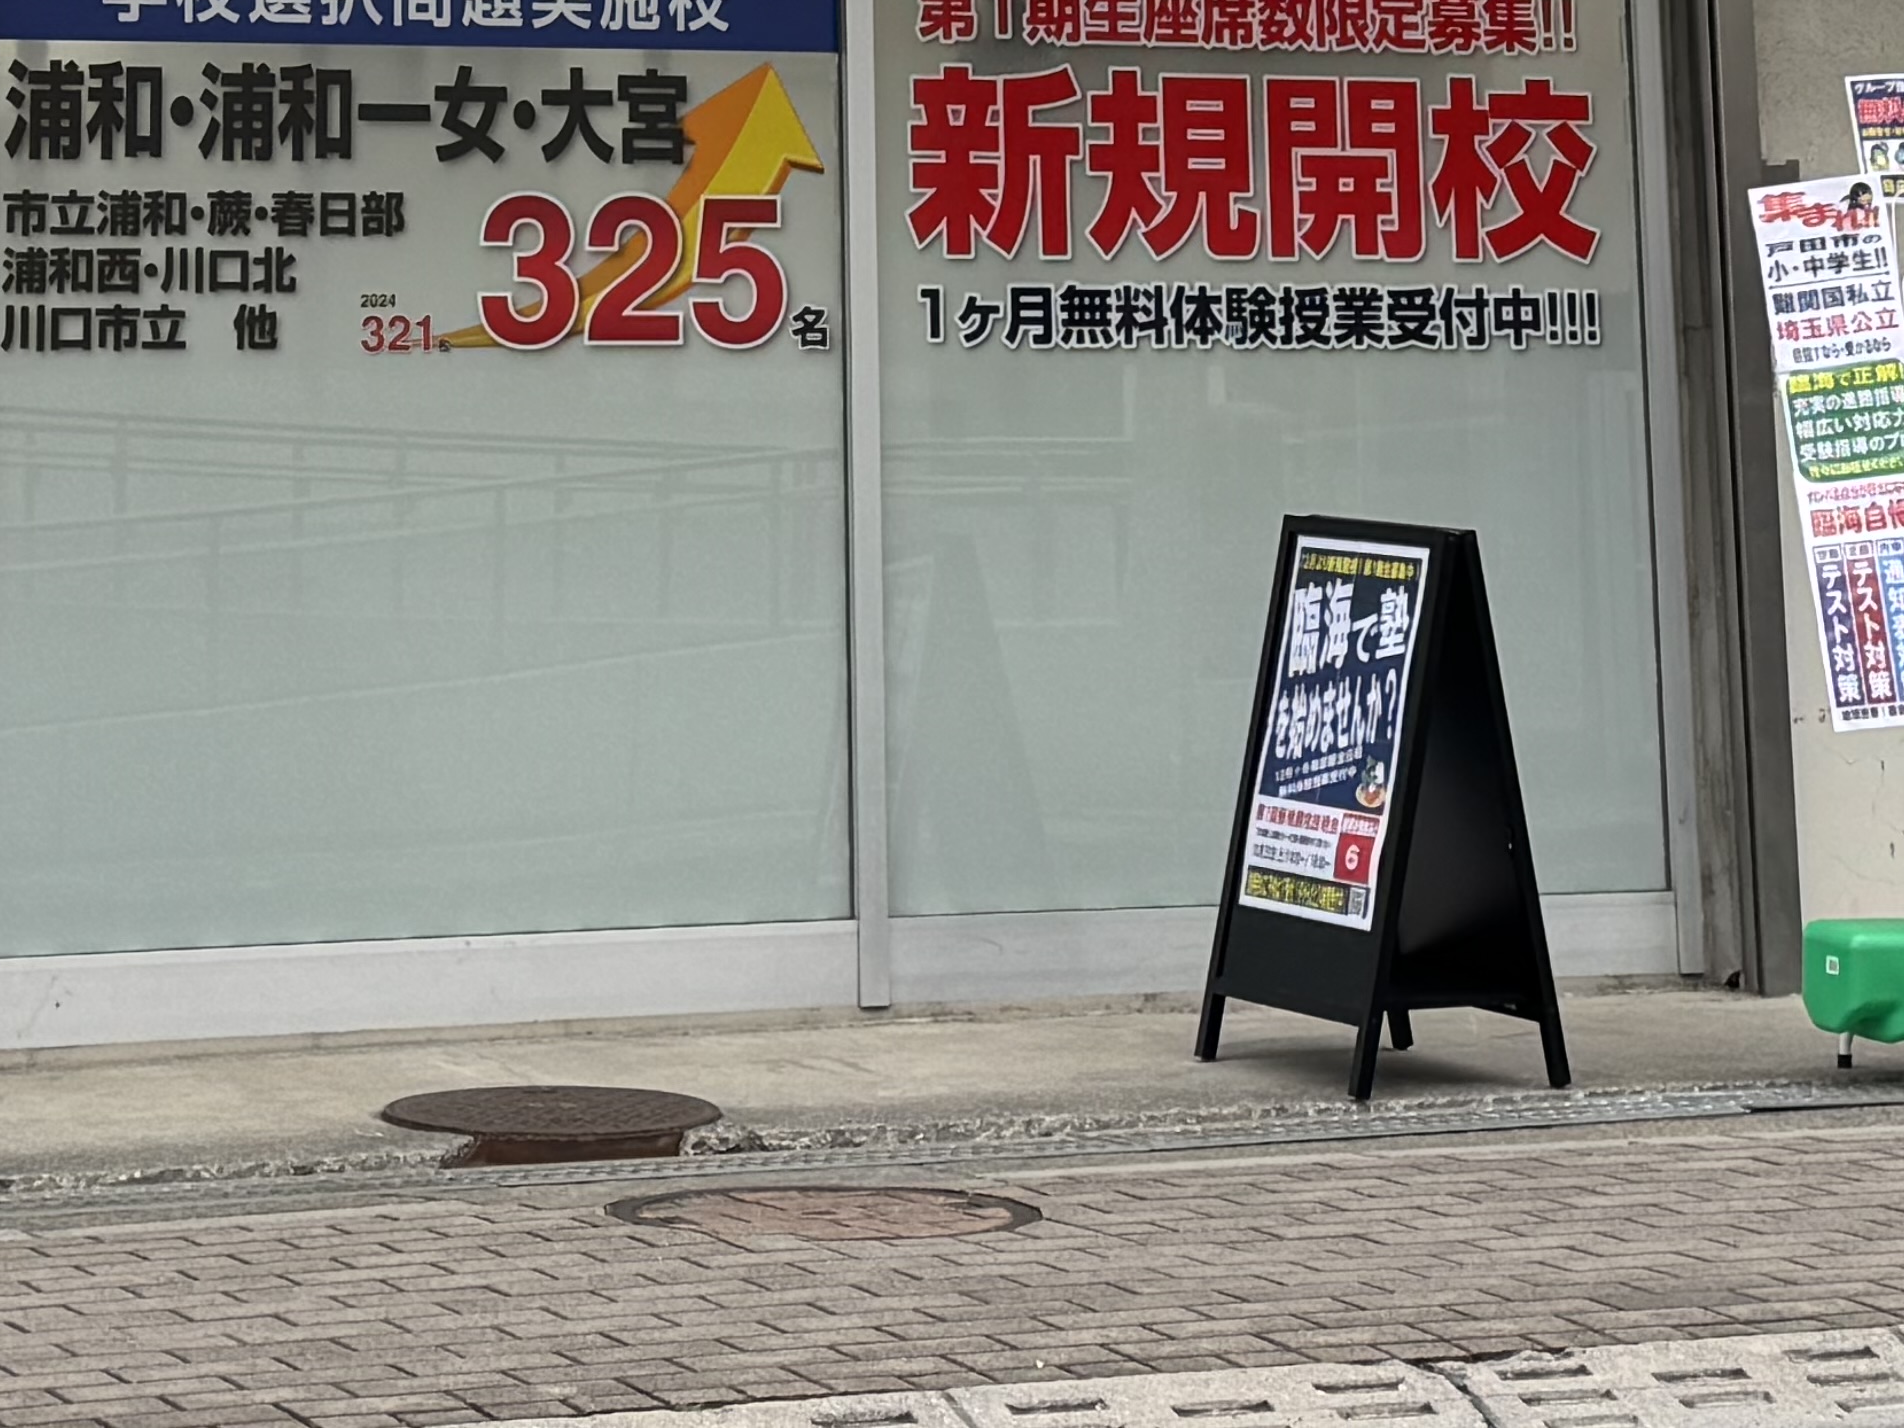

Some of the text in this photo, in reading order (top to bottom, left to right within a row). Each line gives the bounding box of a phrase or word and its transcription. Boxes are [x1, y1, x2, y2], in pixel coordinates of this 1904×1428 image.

[3, 58, 692, 166] 浦和・浦和一女・大宮
[905, 63, 1603, 265] 新規開校
[2, 188, 407, 240] 市立浦和・蕨・春日部
[2, 245, 297, 297] 浦和西・川口北
[359, 293, 397, 309] 2024
[1, 303, 279, 354] 川口市立 他
[1776, 307, 1900, 342] 埼玉県公立
[1287, 577, 1410, 677] 臨海で塾
[1821, 563, 1862, 704] テスト対策
[1852, 560, 1893, 700] テスト対策
